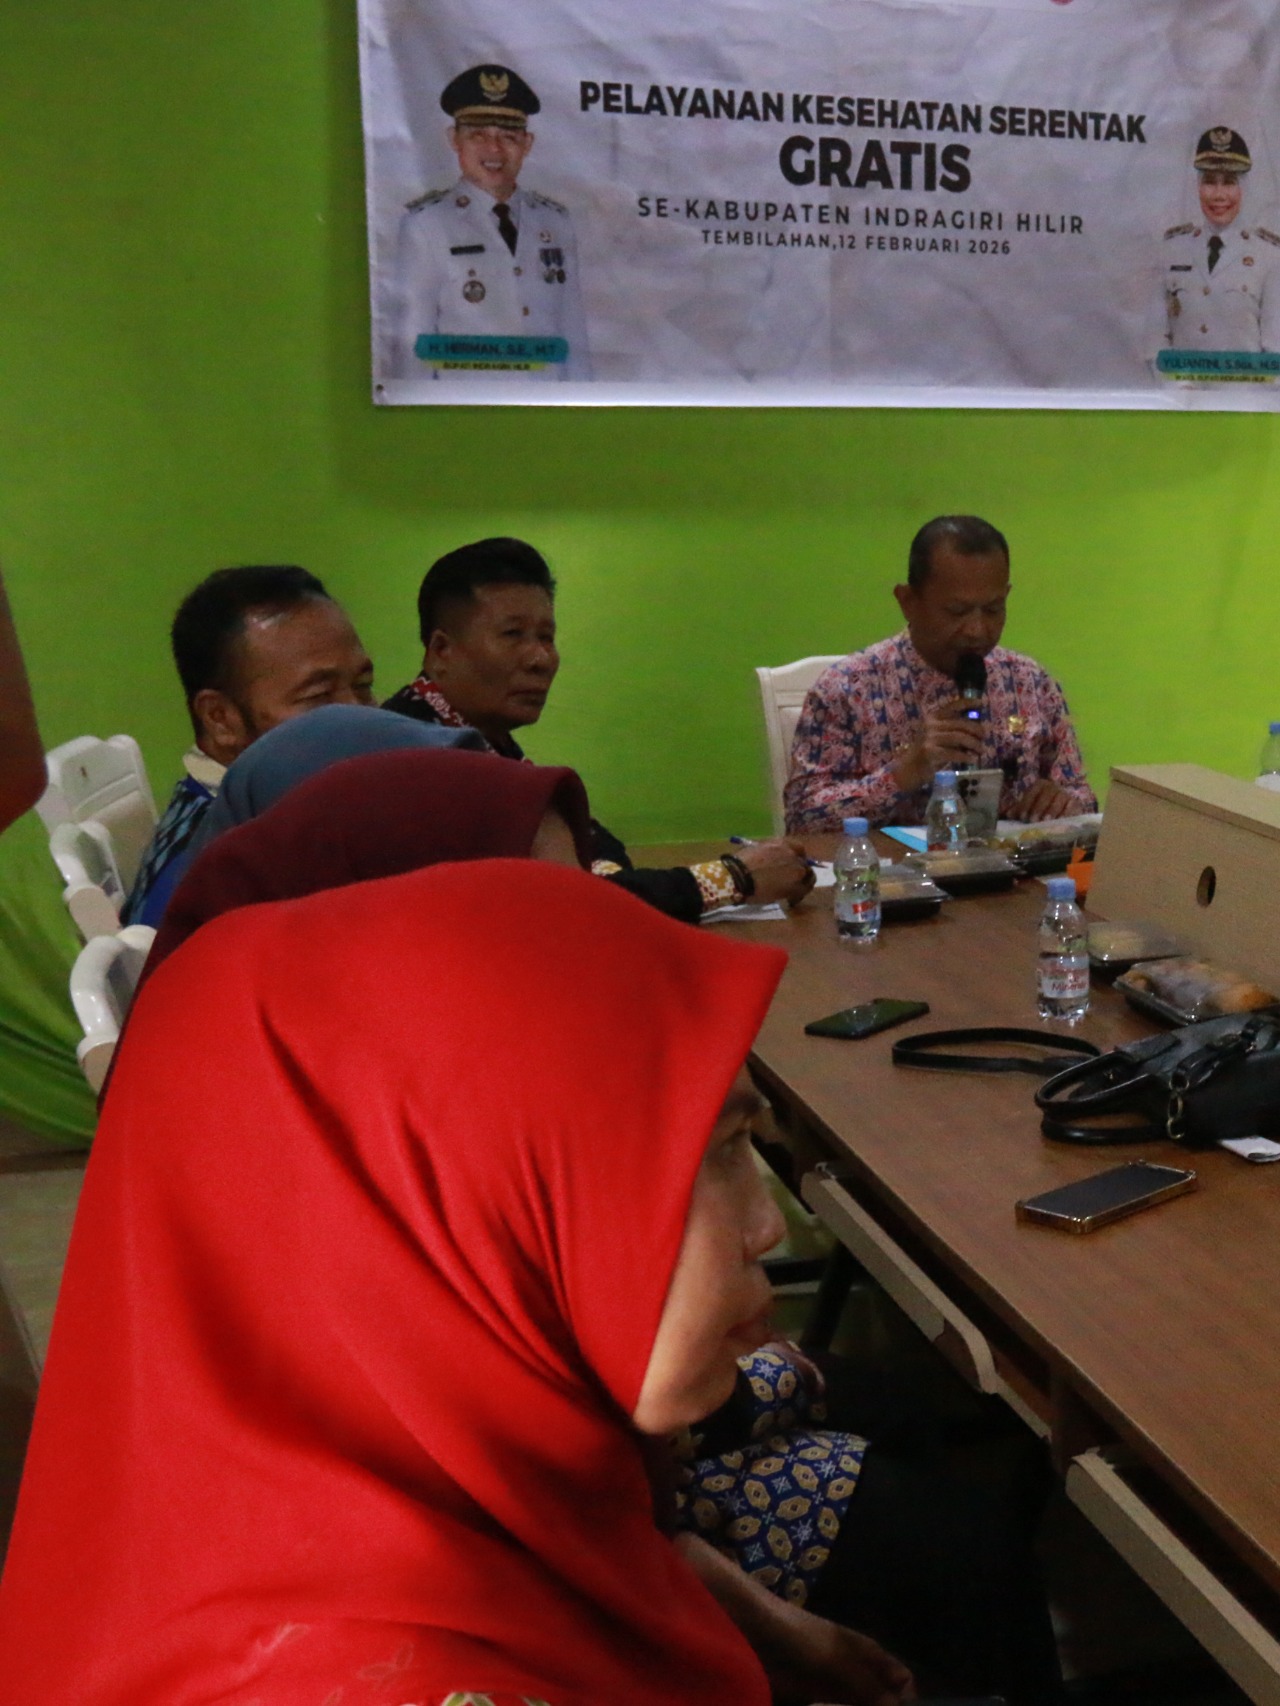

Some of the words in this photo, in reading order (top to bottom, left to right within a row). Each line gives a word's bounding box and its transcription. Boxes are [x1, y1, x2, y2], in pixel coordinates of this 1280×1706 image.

[580, 81, 784, 122] PELAYANAN
[792, 94, 982, 134] KESEHATAN
[989, 106, 1147, 143] SERENTAK
[779, 135, 971, 193] GRATIS
[638, 197, 850, 225] SE-KABUPATEN
[865, 207, 1003, 230] INDRAGIRI
[1017, 213, 1083, 234] HILIR
[866, 235, 959, 253] FEBRUARI
[969, 239, 1011, 254] 2026
